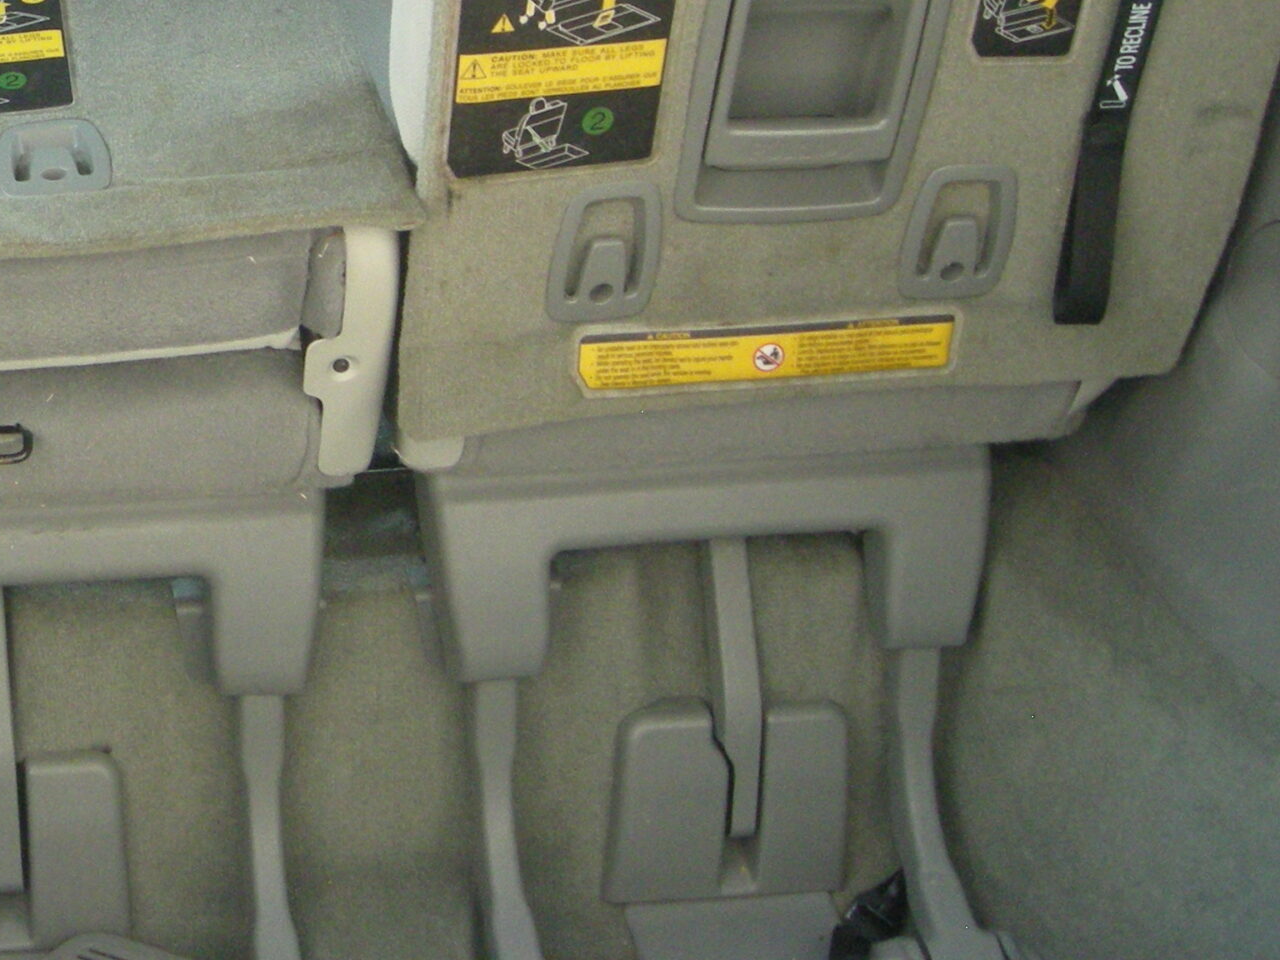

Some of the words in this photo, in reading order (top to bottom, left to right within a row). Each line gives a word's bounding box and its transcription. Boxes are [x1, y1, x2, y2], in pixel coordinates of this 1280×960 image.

[1120, 2, 1152, 53] RECLINE
[1114, 56, 1136, 75] TO
[6, 74, 19, 87] 2
[590, 111, 606, 130] 2
